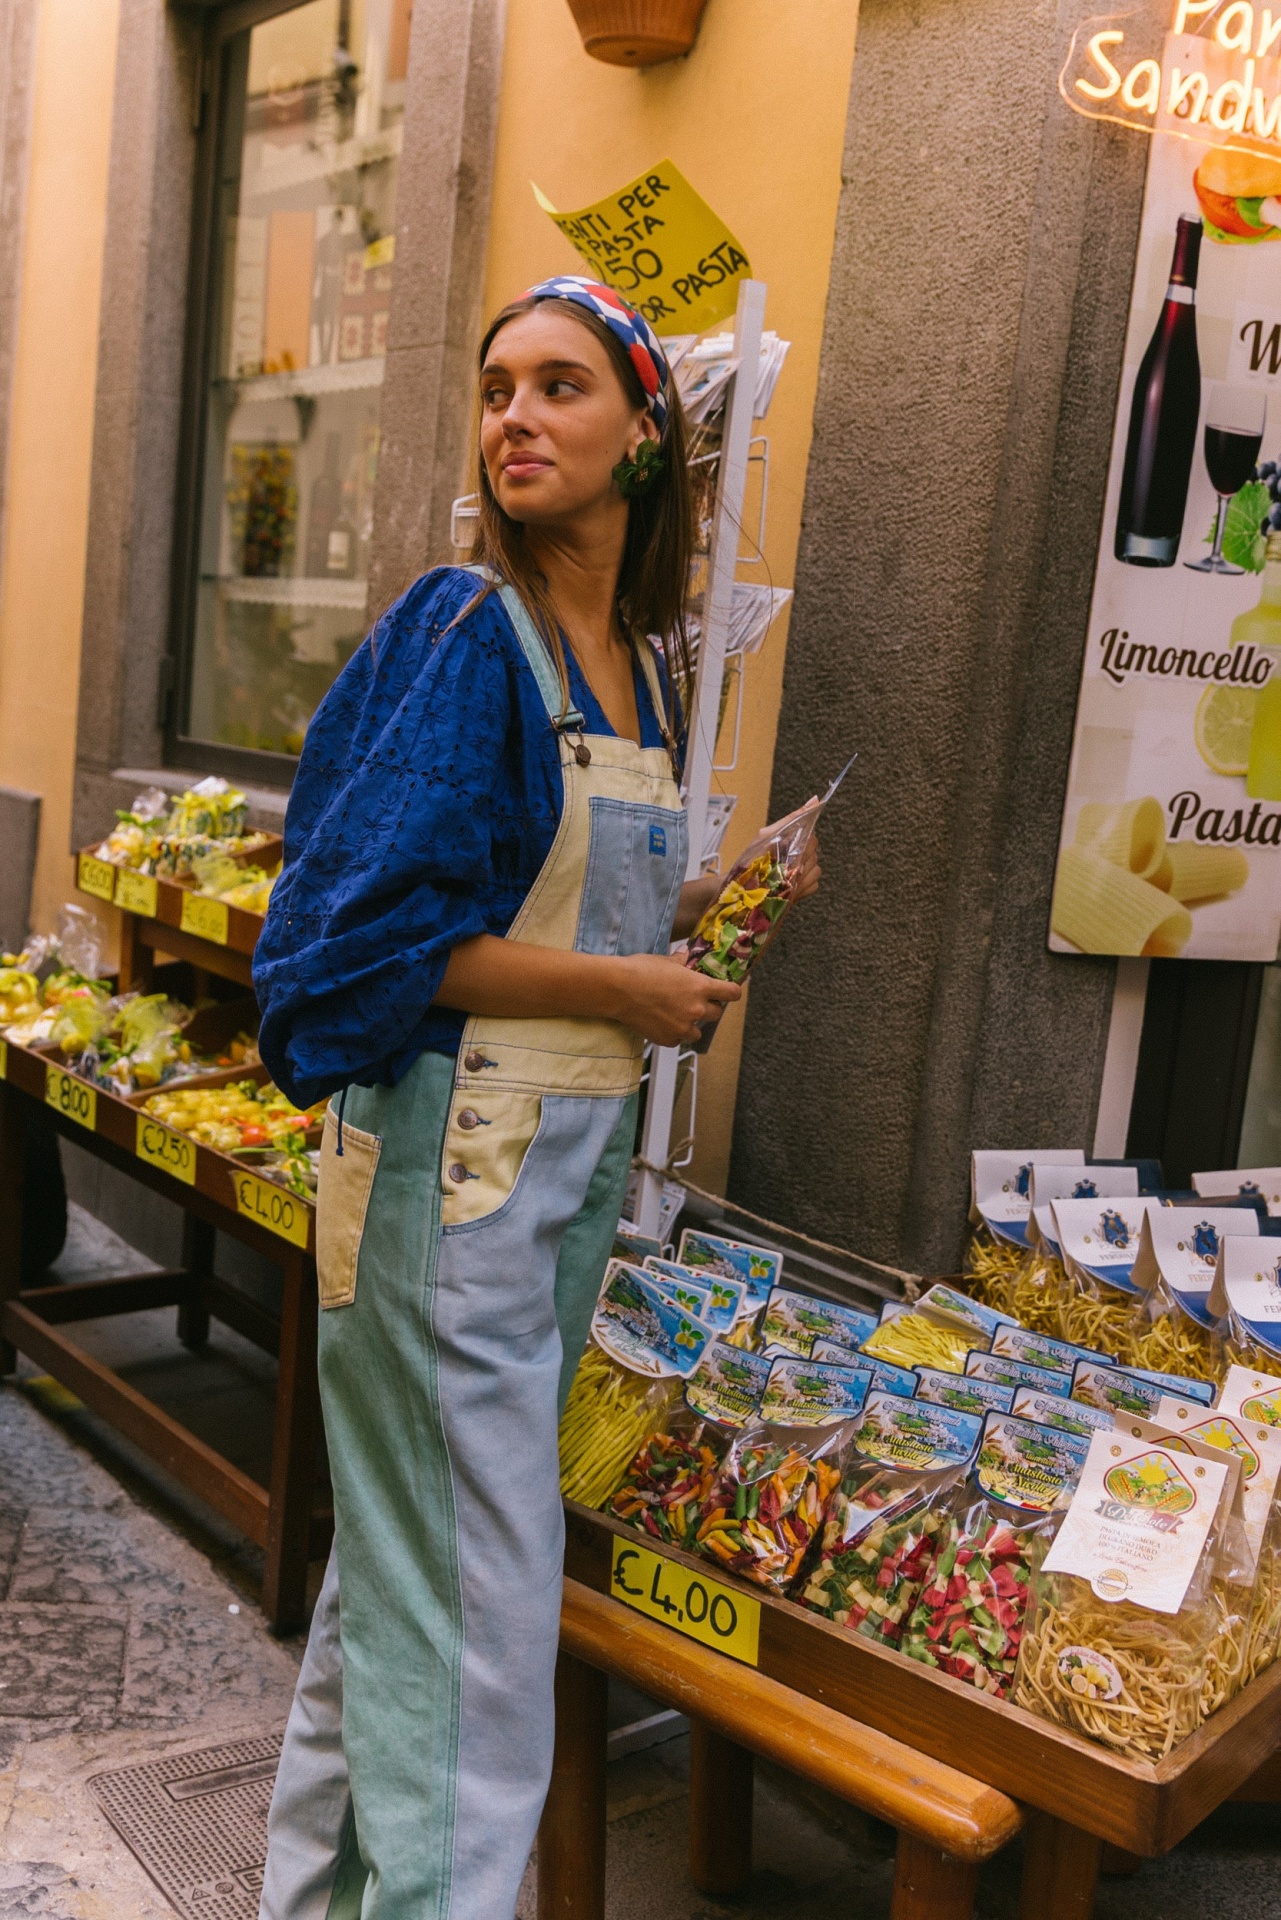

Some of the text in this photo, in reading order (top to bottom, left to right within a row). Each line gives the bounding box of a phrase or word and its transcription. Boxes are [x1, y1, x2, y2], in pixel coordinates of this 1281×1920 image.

[617, 174, 670, 218] PER
[586, 214, 666, 258] PASTA
[672, 241, 749, 305] PASTA
[1100, 628, 1274, 684] Limoncello
[1168, 790, 1281, 846] Pasta
[613, 1549, 737, 1637] €4,00
